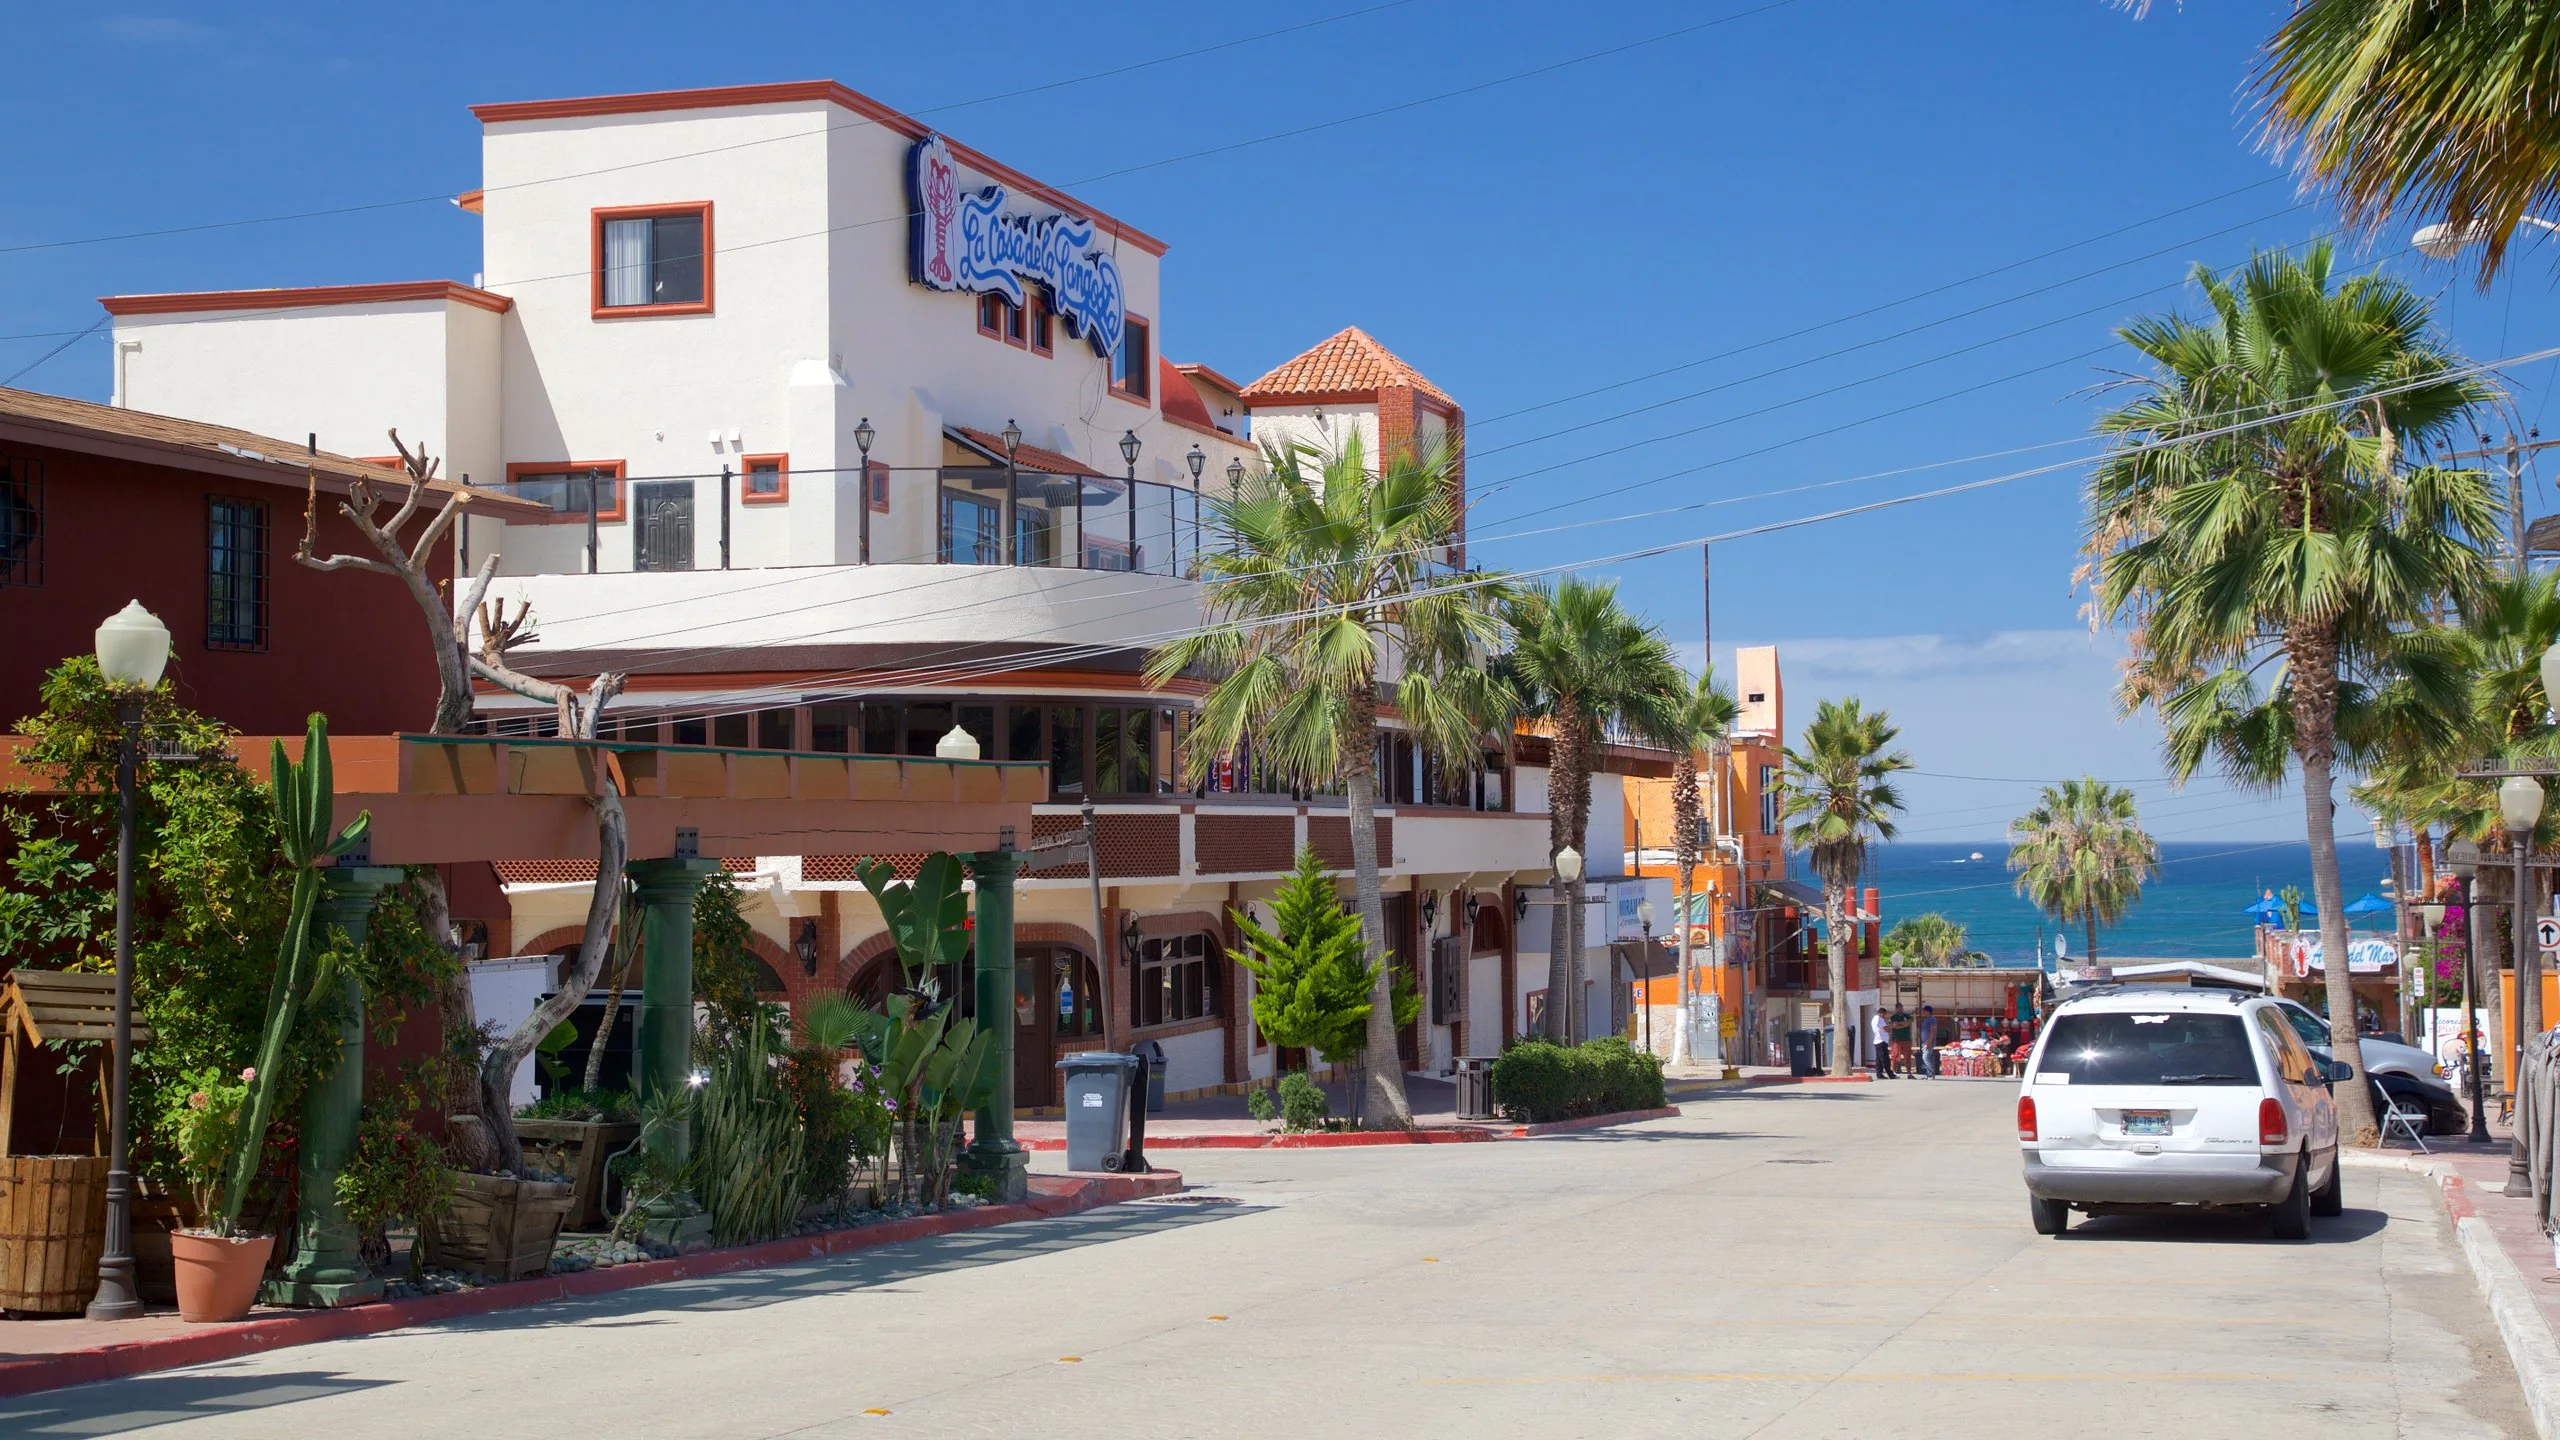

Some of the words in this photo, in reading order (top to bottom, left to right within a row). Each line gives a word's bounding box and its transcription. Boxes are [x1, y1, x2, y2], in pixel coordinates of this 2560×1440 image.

[989, 215, 1025, 266] Casa
[1041, 228, 1055, 279] la
[1055, 226, 1122, 349] Langosta
[2348, 944, 2364, 963] del
[2367, 943, 2394, 963] Mar
